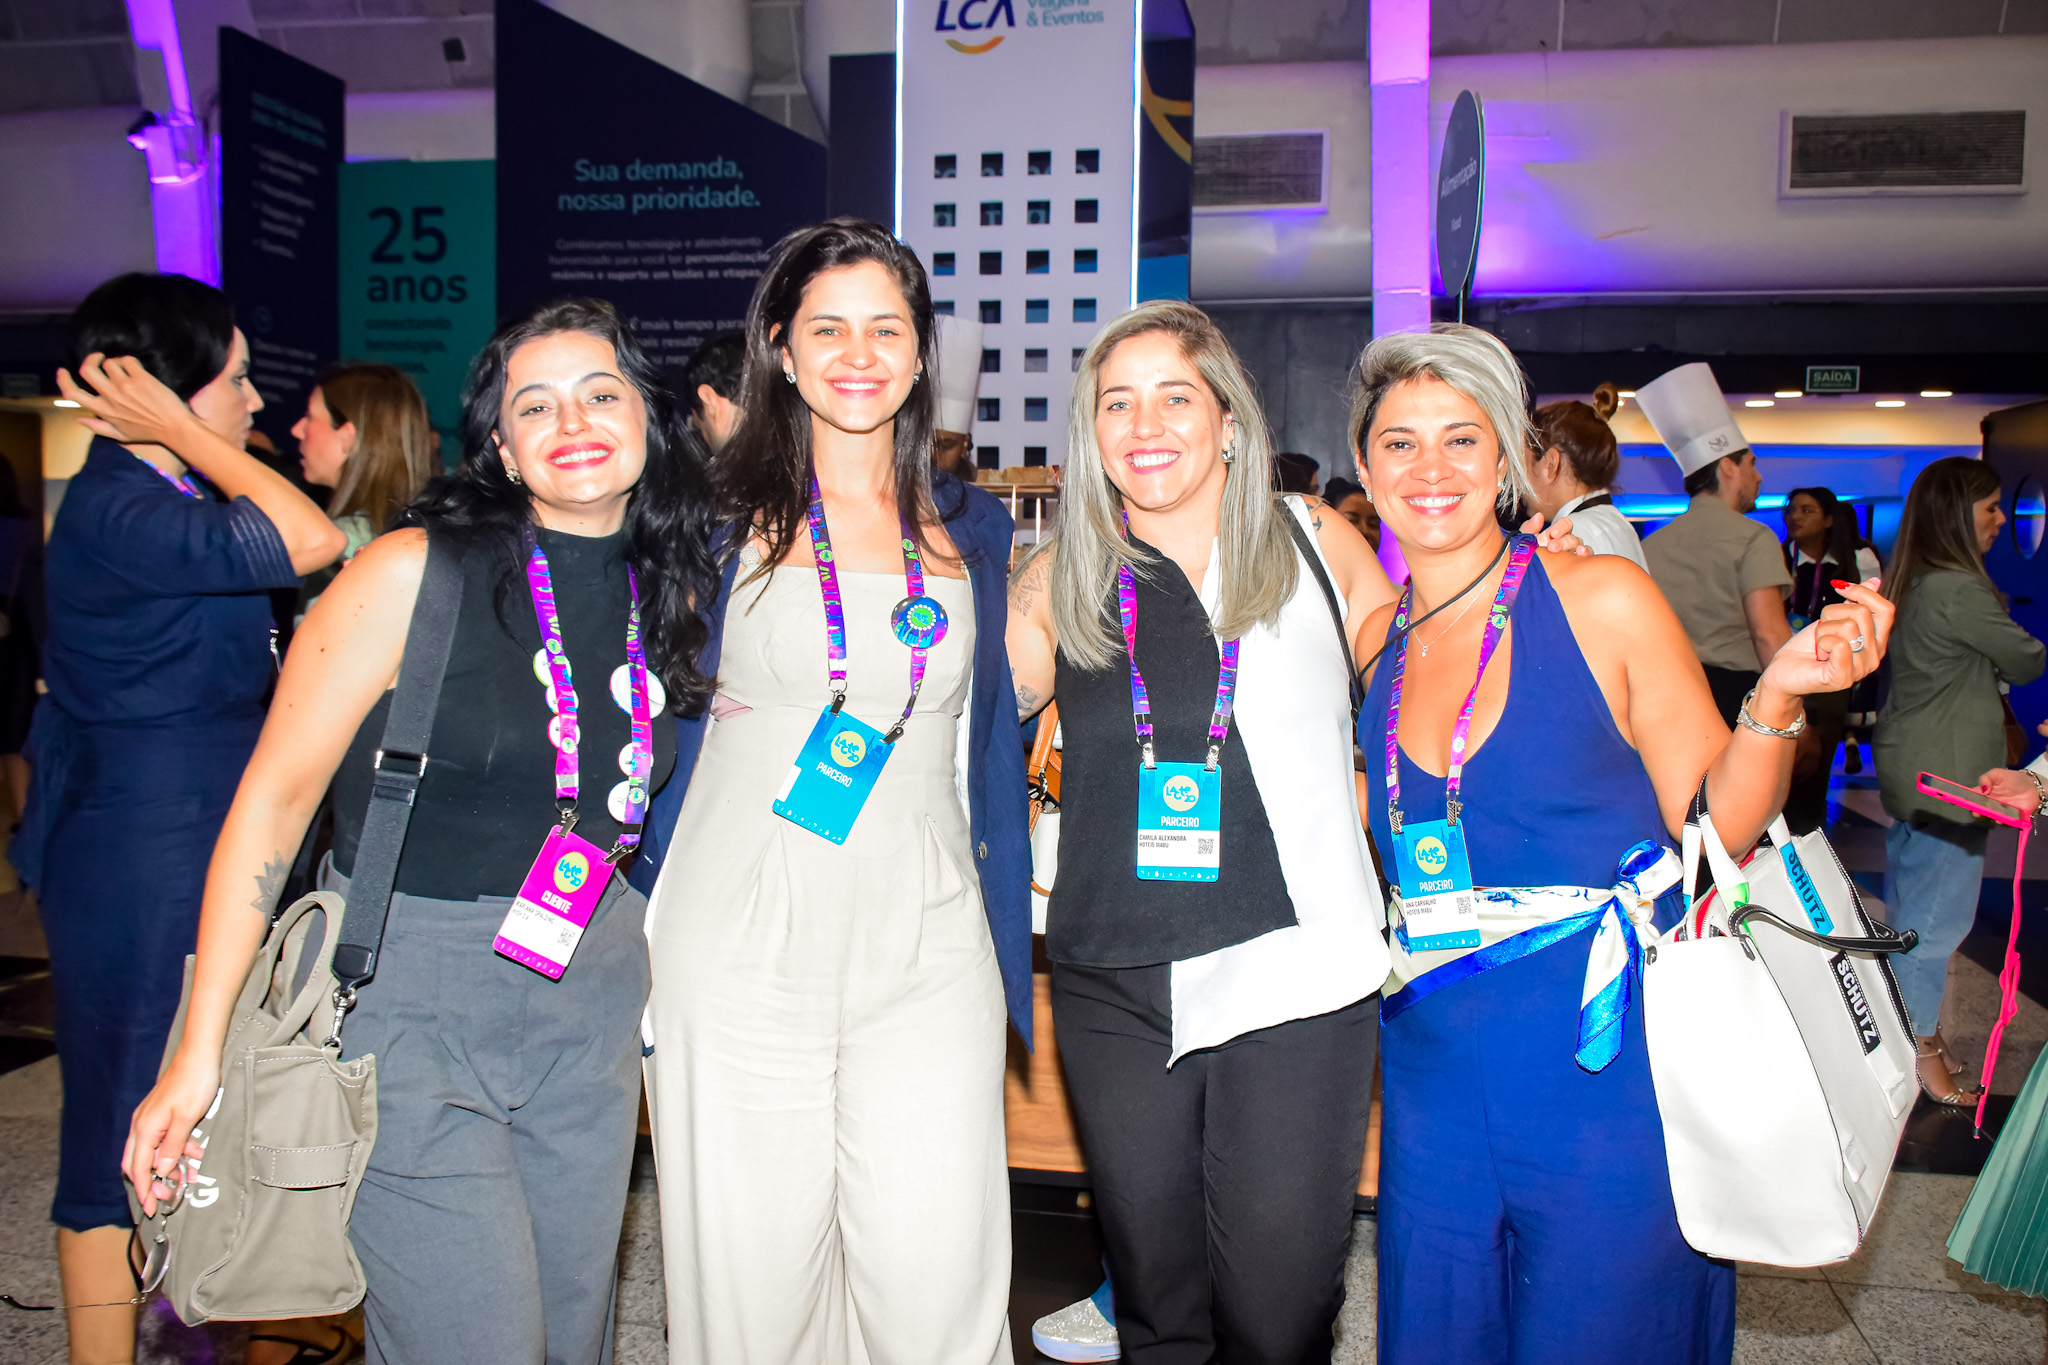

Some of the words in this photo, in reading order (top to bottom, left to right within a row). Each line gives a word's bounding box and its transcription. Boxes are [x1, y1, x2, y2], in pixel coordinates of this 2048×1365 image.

[935, 0, 1016, 31] LCA
[1026, 13, 1038, 27] &
[1042, 9, 1104, 26] Eventos
[575, 158, 620, 182] Sua
[625, 155, 744, 180] demanda,
[558, 193, 626, 211] nossa
[632, 185, 760, 214] prioridade.
[368, 206, 448, 263] 25
[366, 275, 468, 303] anos
[1813, 370, 1852, 382] SAÍDA
[816, 762, 853, 788] PARCEIRO
[1161, 816, 1199, 827] PARCEIRO
[1419, 879, 1453, 893] PARCEIRO
[1787, 850, 1826, 929] SCHUTZ
[541, 890, 573, 914] CLIENTE
[1415, 899, 1436, 907] CARVALHO
[1836, 959, 1878, 1044] SCHUTZ
